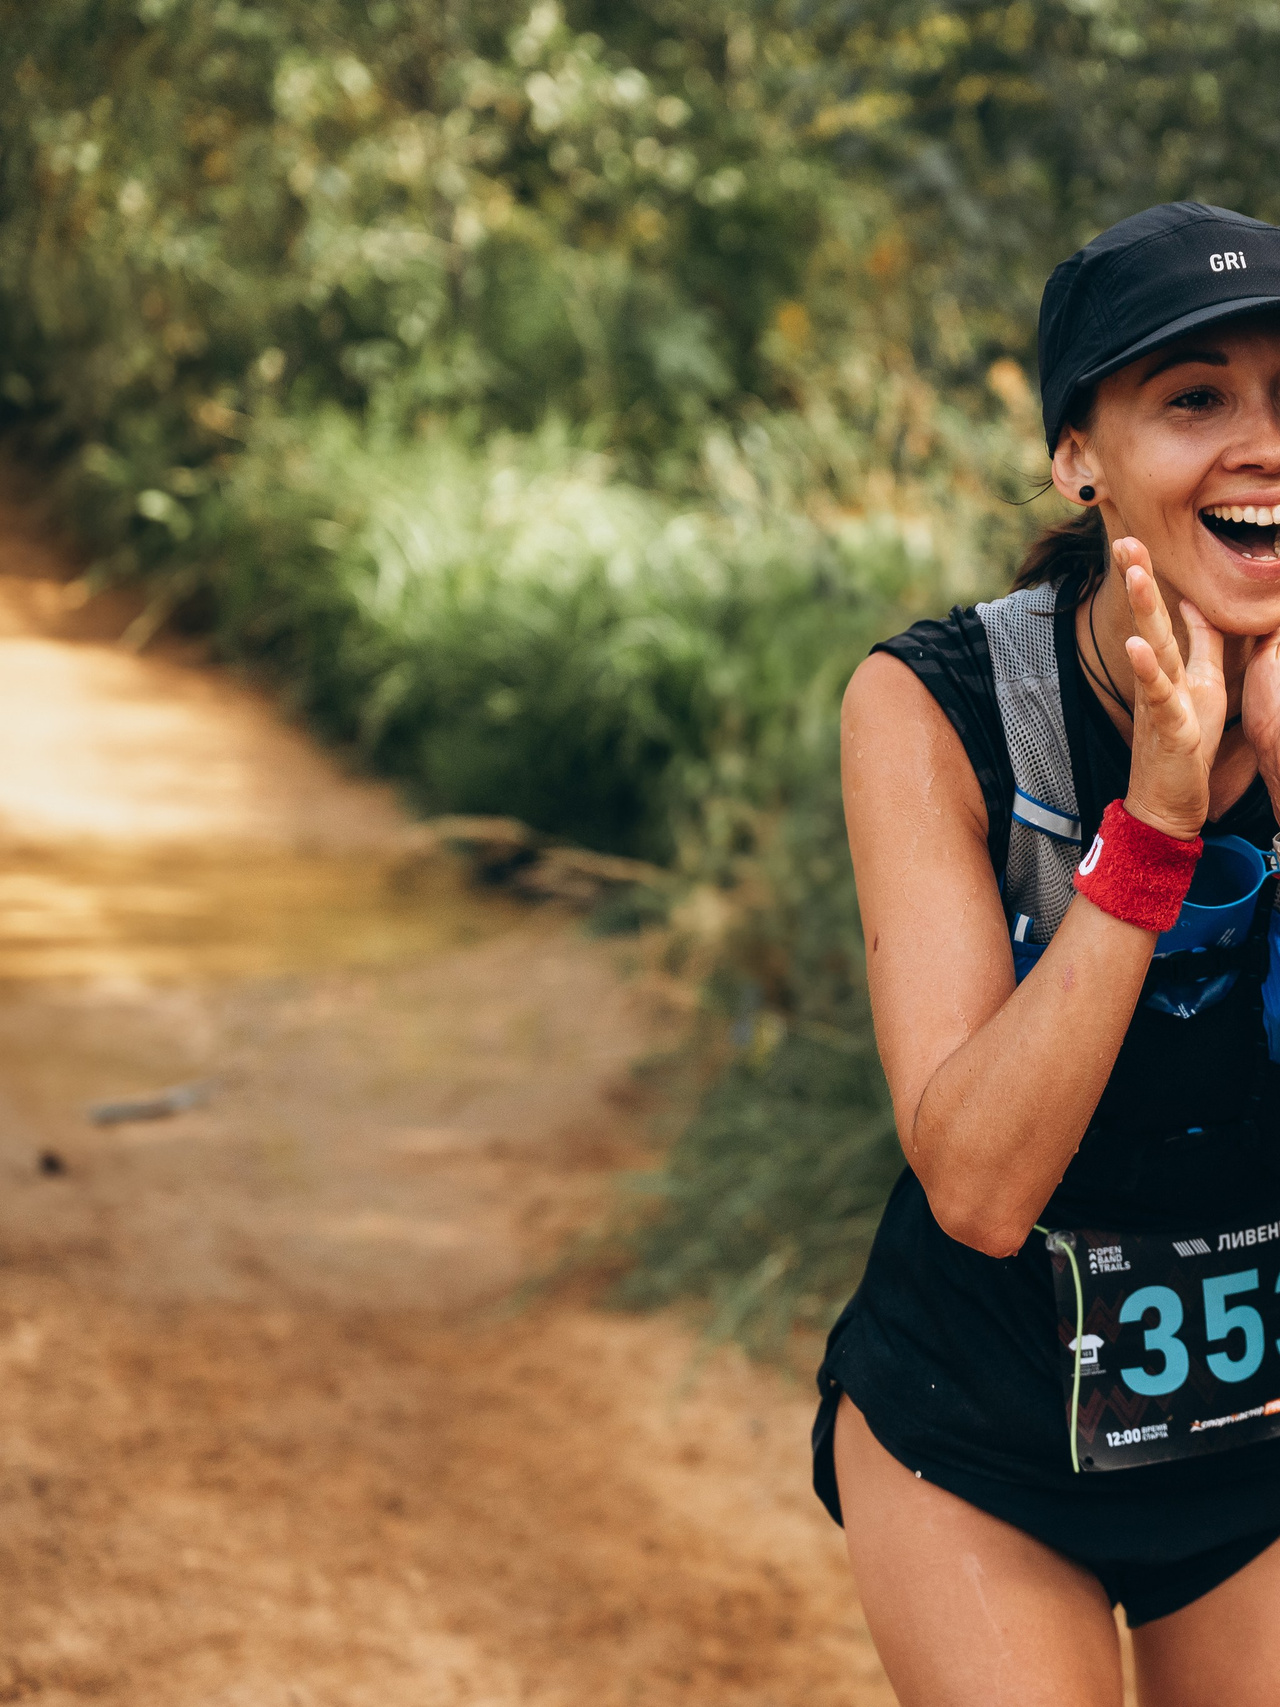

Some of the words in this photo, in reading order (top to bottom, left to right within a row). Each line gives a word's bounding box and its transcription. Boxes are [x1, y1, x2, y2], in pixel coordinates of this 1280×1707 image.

[1209, 251, 1247, 272] GRi
[1096, 1245, 1122, 1256] OPEN
[1099, 1260, 1131, 1273] TRAILS
[1106, 1428, 1142, 1447] 12:00
